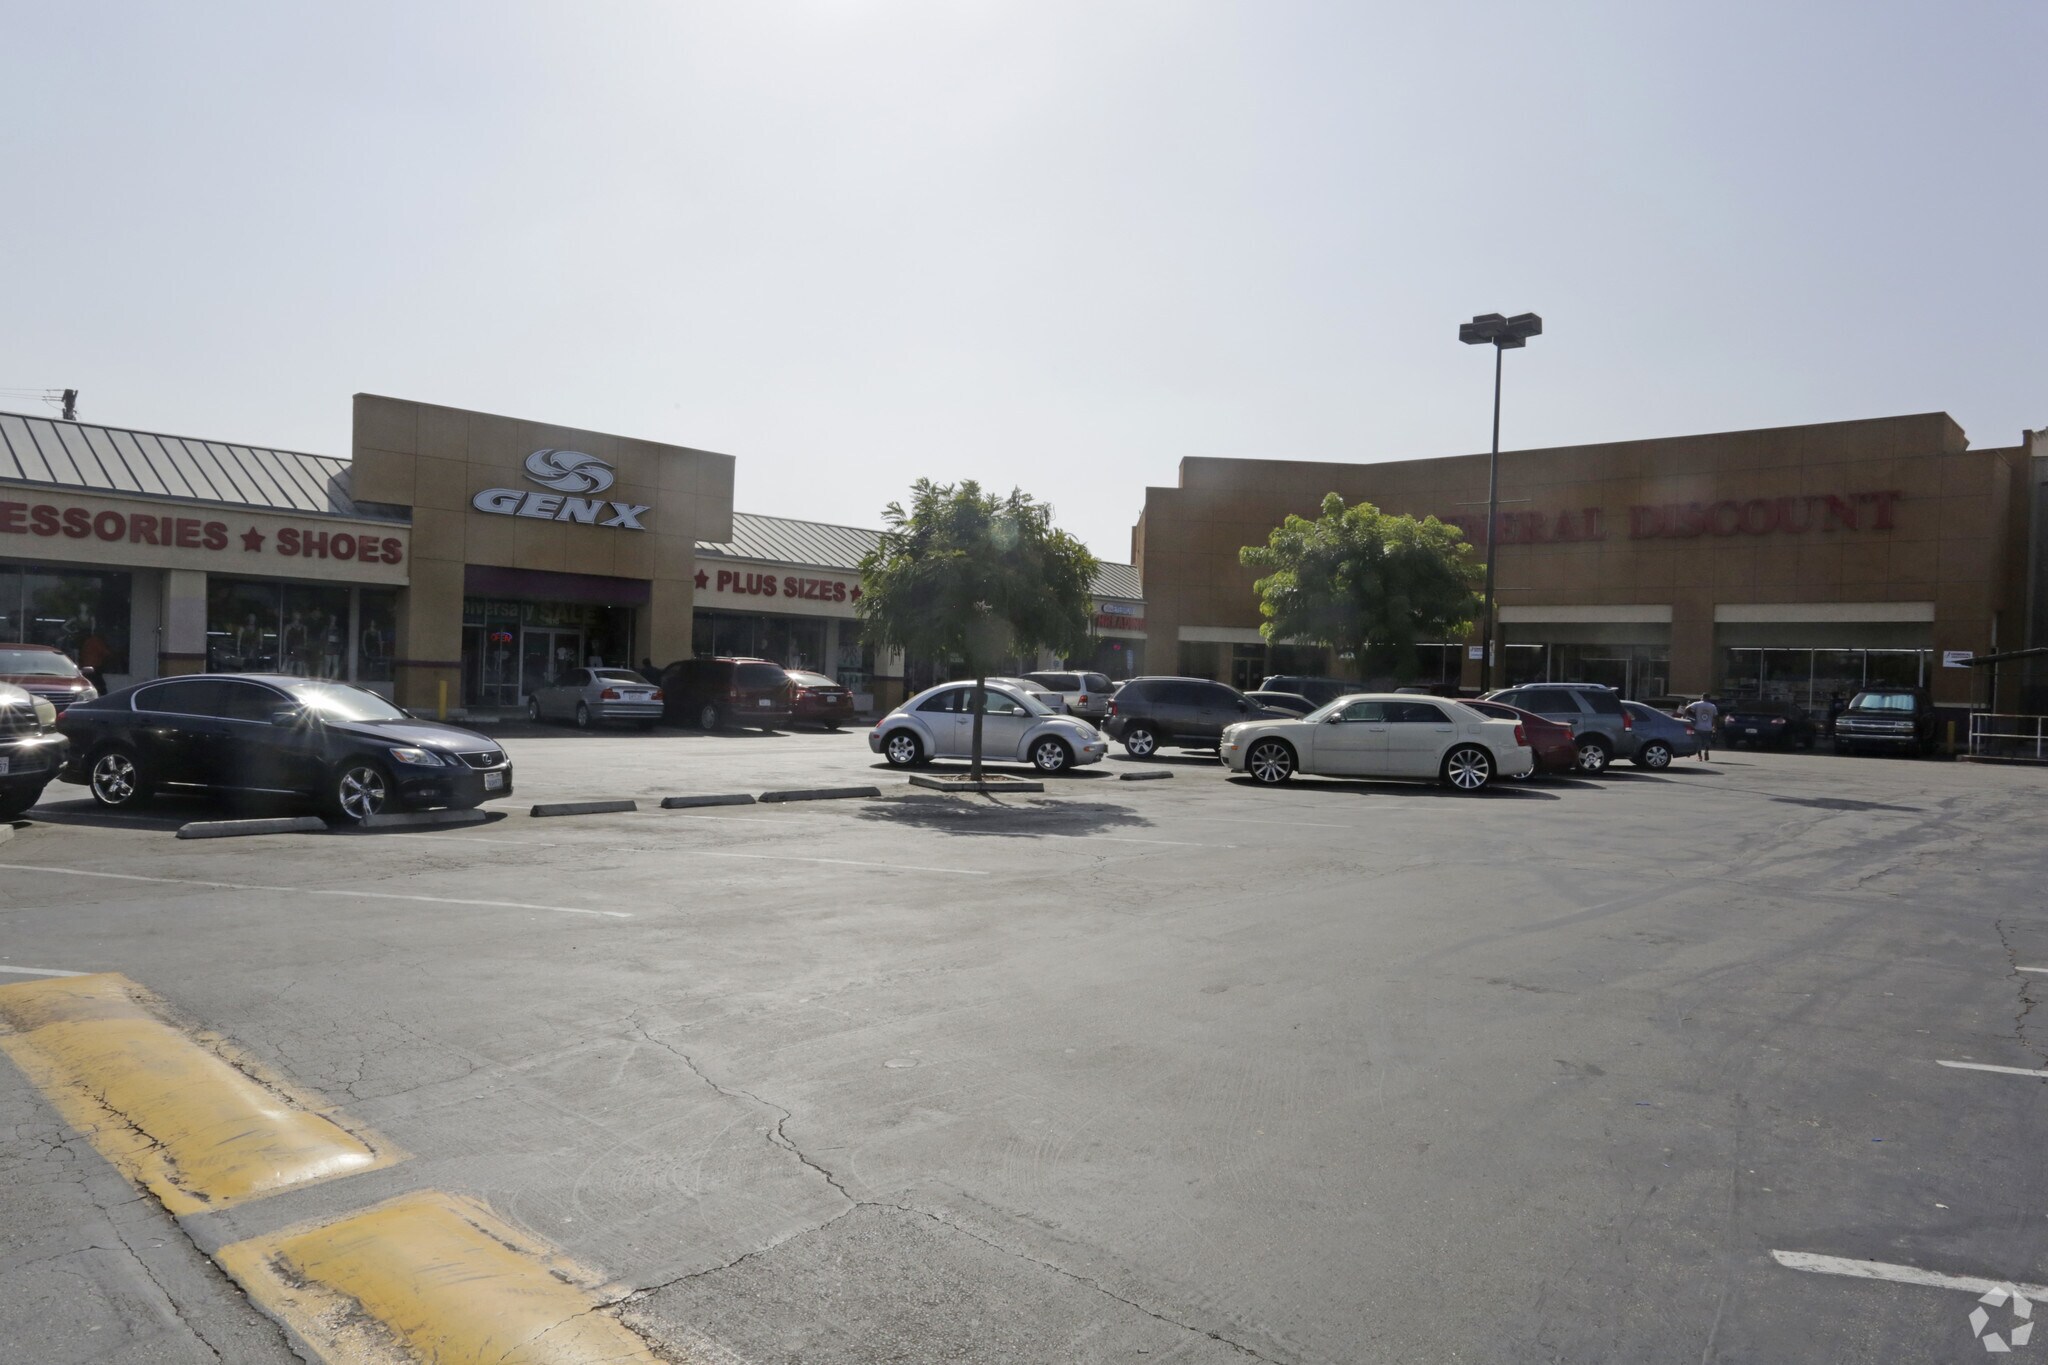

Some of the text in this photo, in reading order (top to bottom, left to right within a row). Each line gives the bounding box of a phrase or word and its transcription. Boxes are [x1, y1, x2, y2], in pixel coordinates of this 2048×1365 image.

[472, 487, 651, 531] GENX
[1628, 490, 1902, 540] DISCOUNT
[0, 501, 403, 565] ESSORIES SHOES
[717, 569, 847, 602] PLUS SIZES
[490, 633, 512, 643] OPEN
